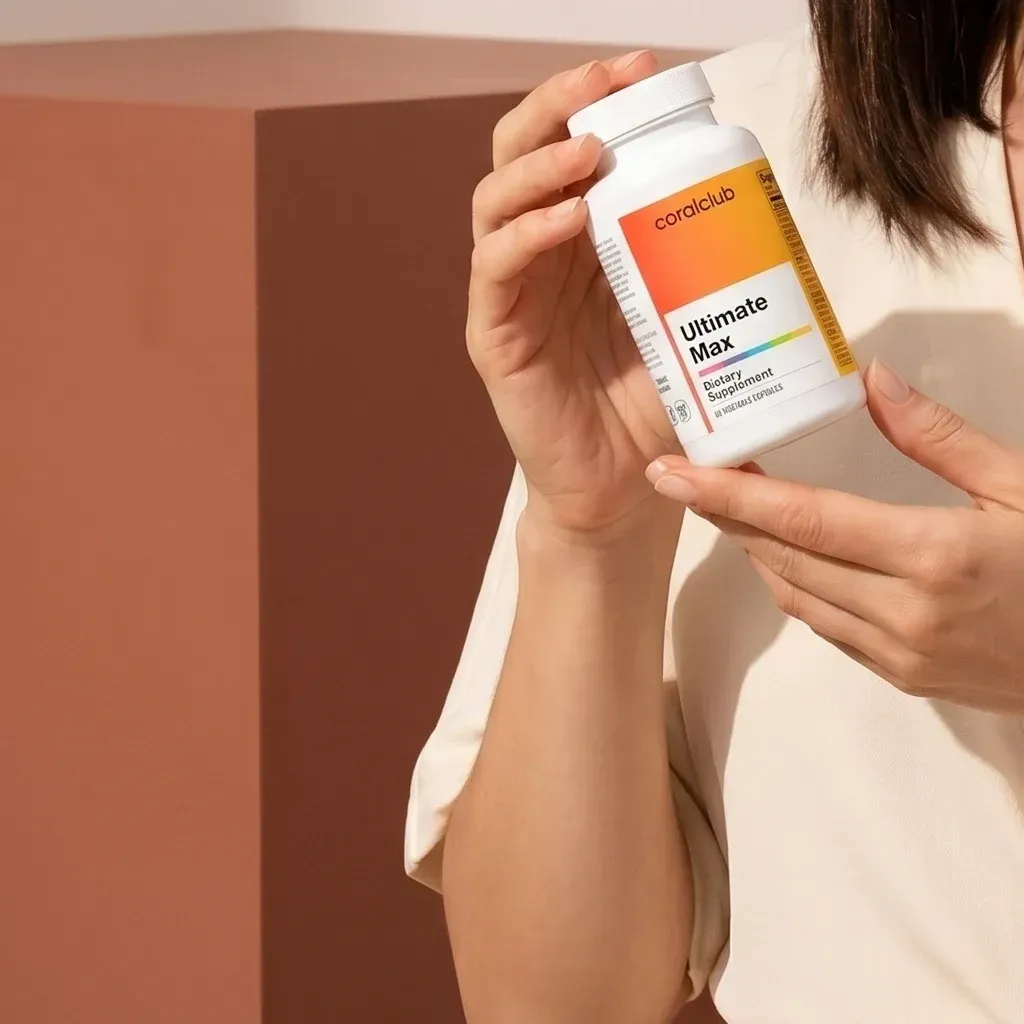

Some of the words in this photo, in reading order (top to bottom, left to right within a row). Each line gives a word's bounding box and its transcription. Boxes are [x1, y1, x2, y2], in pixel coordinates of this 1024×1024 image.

[655, 186, 735, 230] coralclub
[680, 296, 768, 342] Ultimate
[689, 335, 735, 365] Max
